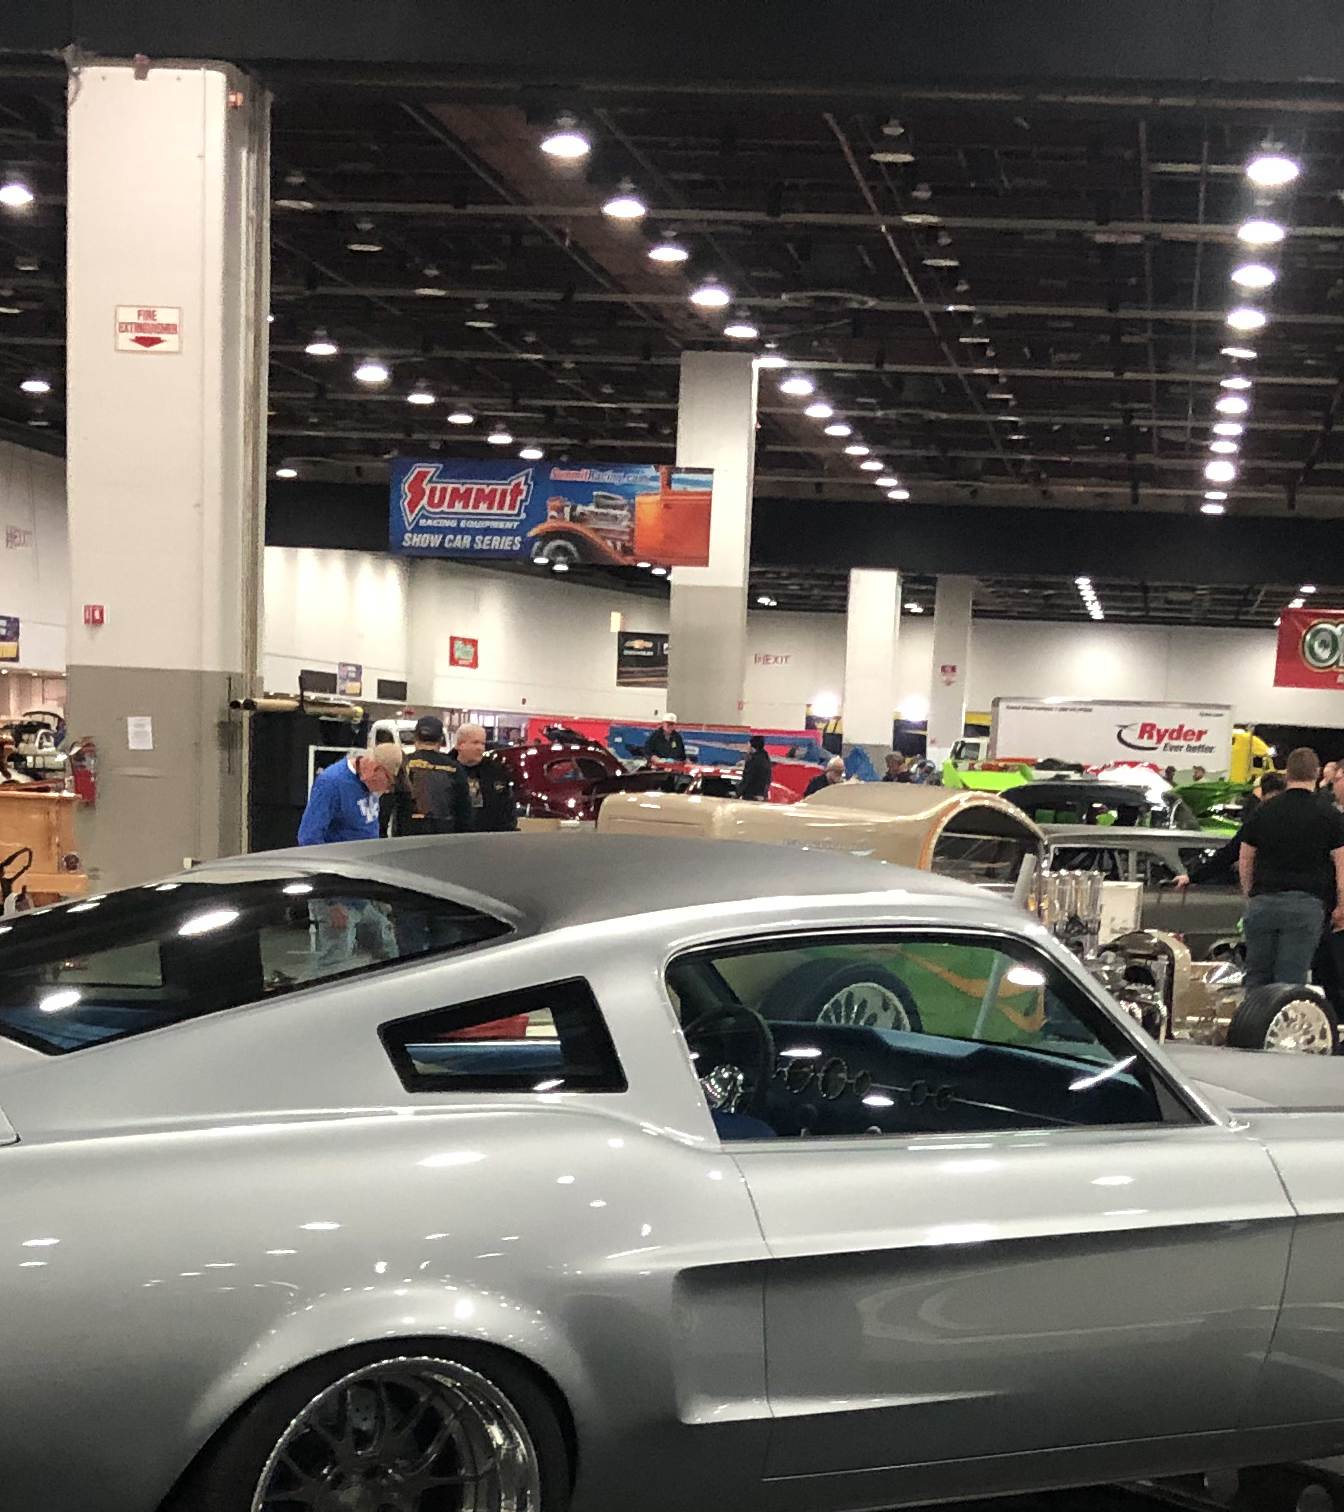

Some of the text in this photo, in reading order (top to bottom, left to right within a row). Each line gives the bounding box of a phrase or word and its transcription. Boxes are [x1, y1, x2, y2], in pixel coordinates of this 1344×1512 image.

[137, 309, 157, 321] FIRE
[402, 532, 522, 550] SHOW CAR SERIES
[763, 654, 791, 665] EXIT
[1137, 722, 1208, 745] Ryder
[1163, 743, 1216, 753] Ever better
